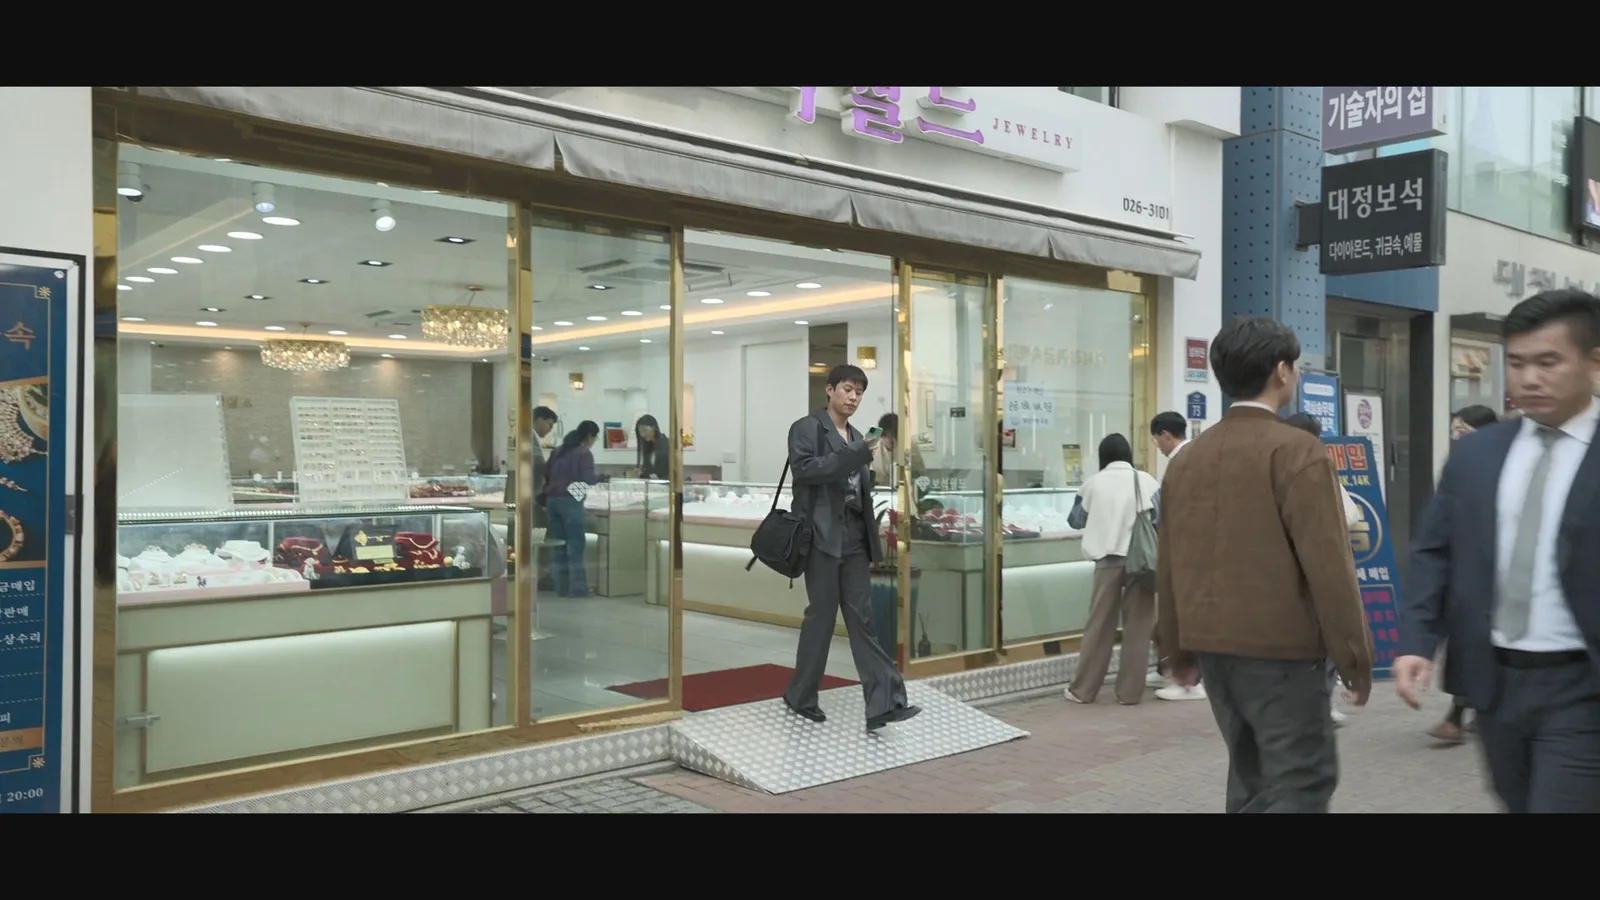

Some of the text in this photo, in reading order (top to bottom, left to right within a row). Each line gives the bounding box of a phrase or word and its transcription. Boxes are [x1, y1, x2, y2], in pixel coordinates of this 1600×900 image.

[797, 87, 984, 144] 월드
[1328, 87, 1402, 130] 기술자의
[992, 117, 1073, 149] JEWELRY
[1123, 197, 1169, 220] 026-3101
[1328, 177, 1423, 220] 대정보석
[0, 321, 36, 350] 속
[0, 605, 29, 618] 판매
[0, 631, 40, 645] 상수리
[7, 788, 43, 802] 20:00
